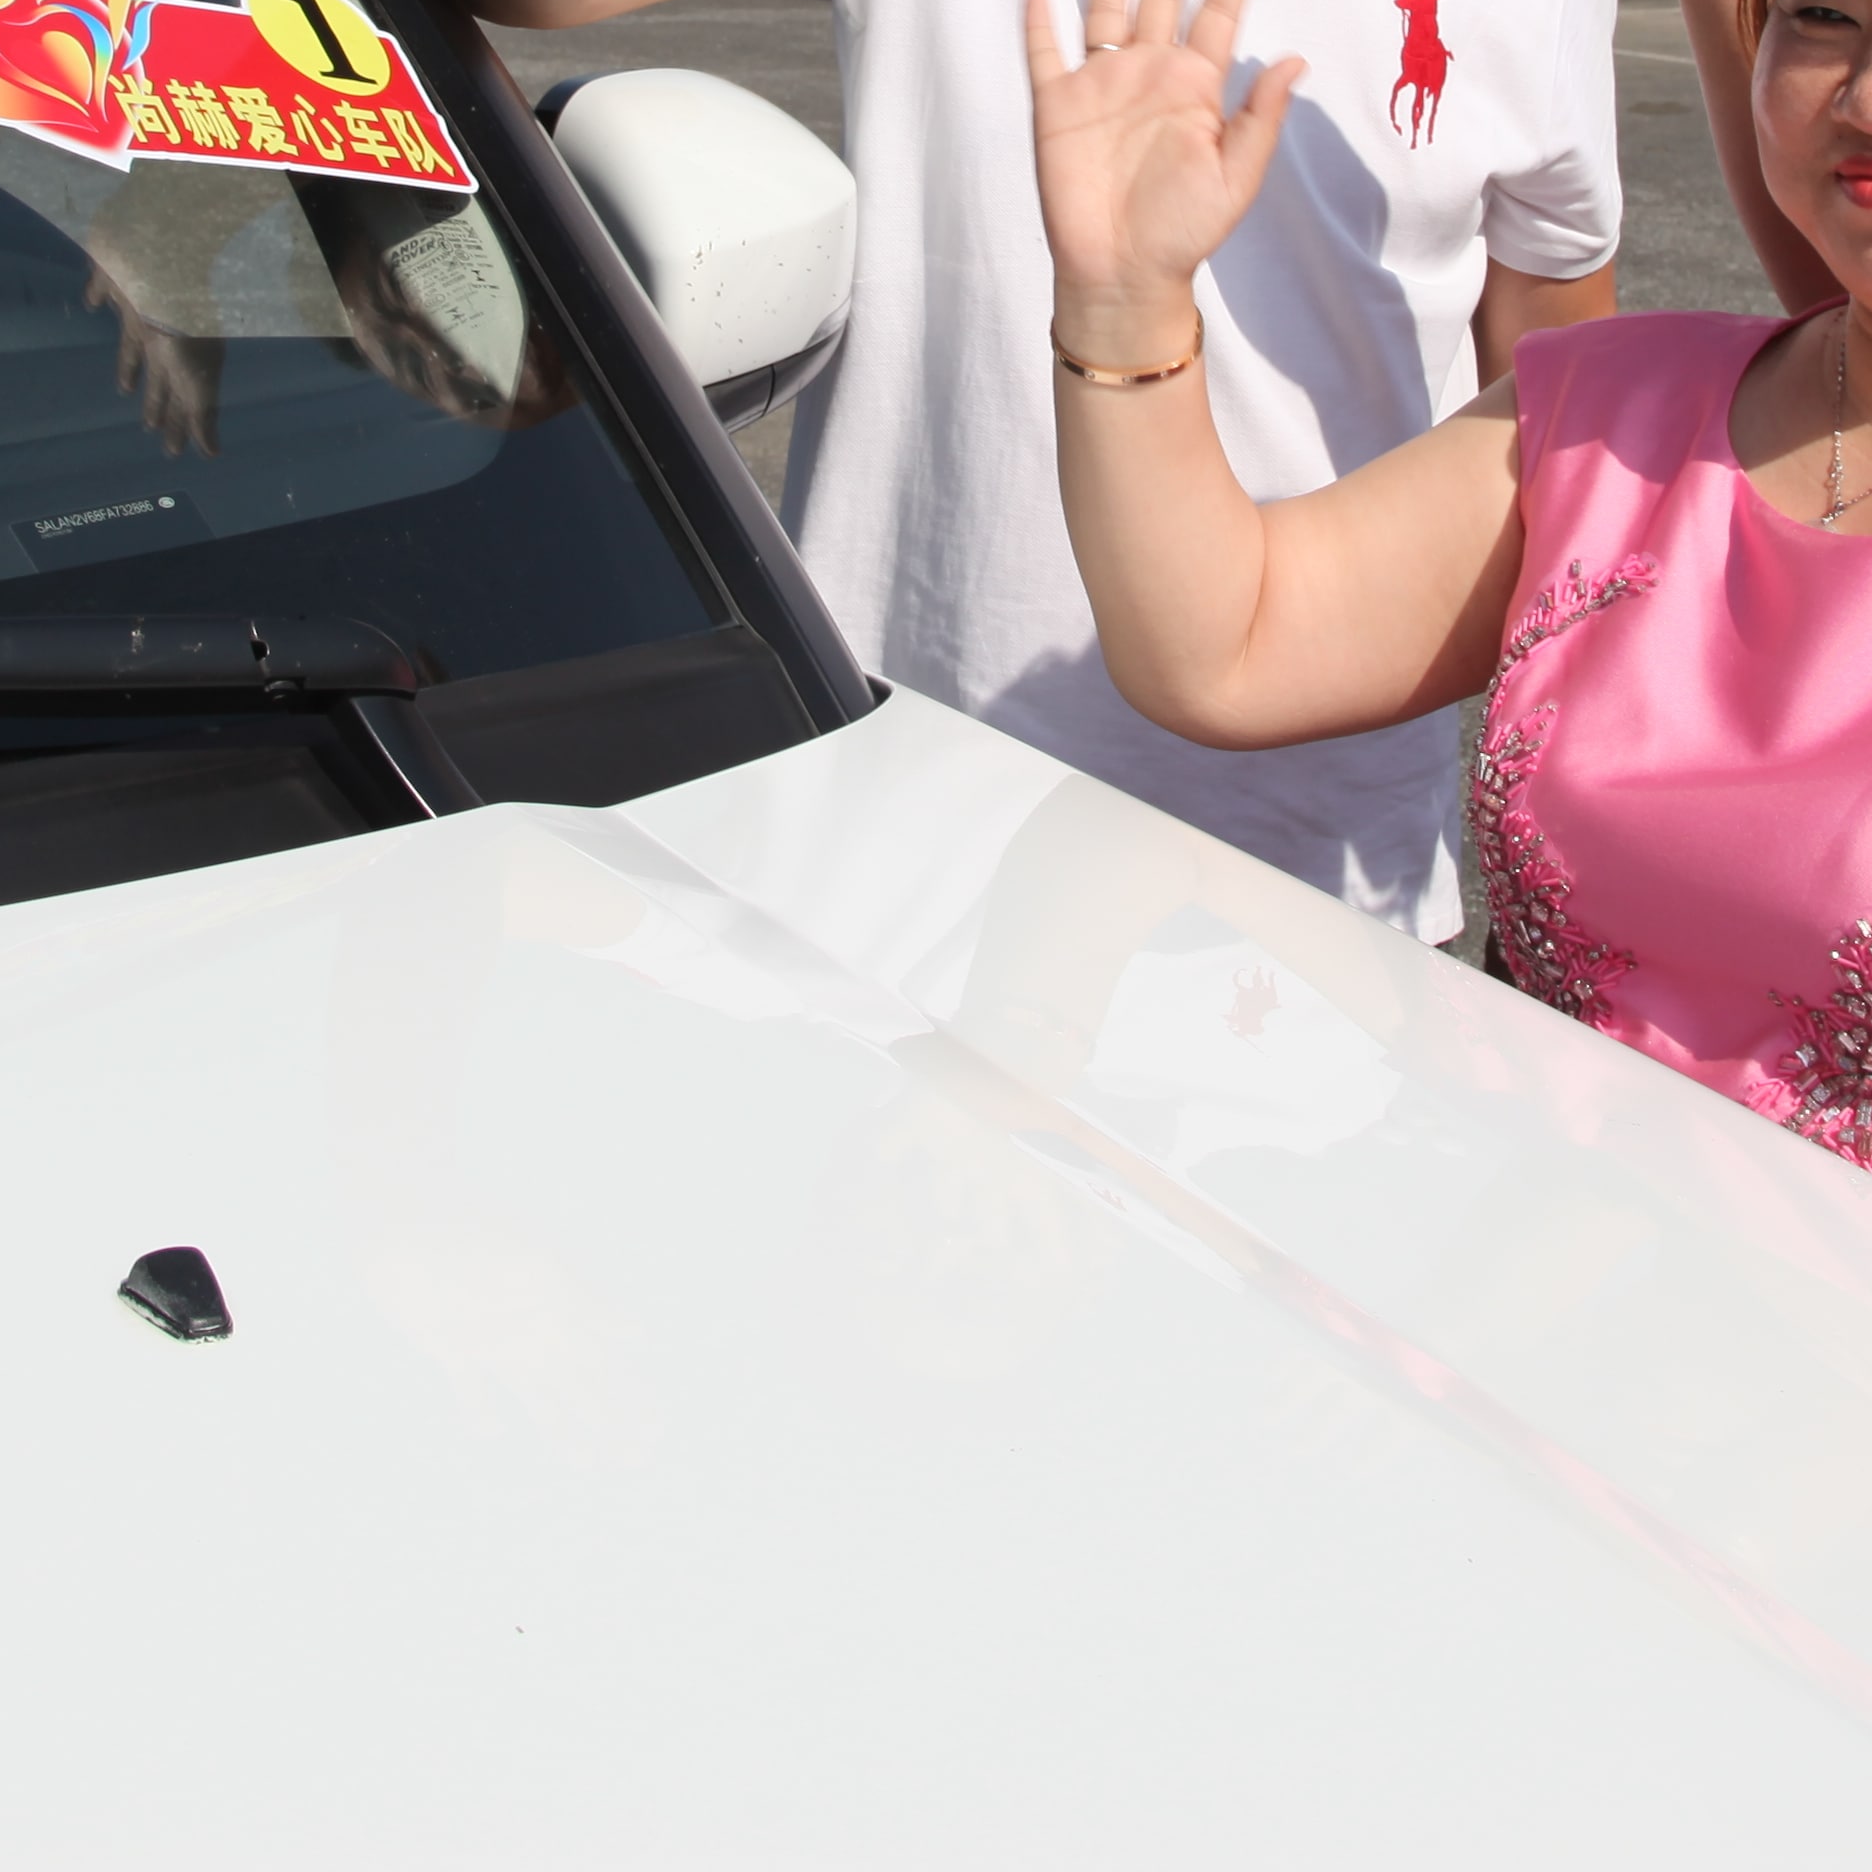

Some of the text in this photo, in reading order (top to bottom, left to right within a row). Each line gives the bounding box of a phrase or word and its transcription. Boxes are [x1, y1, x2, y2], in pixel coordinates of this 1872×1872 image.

[109, 73, 455, 178] 尚赫爱心车队
